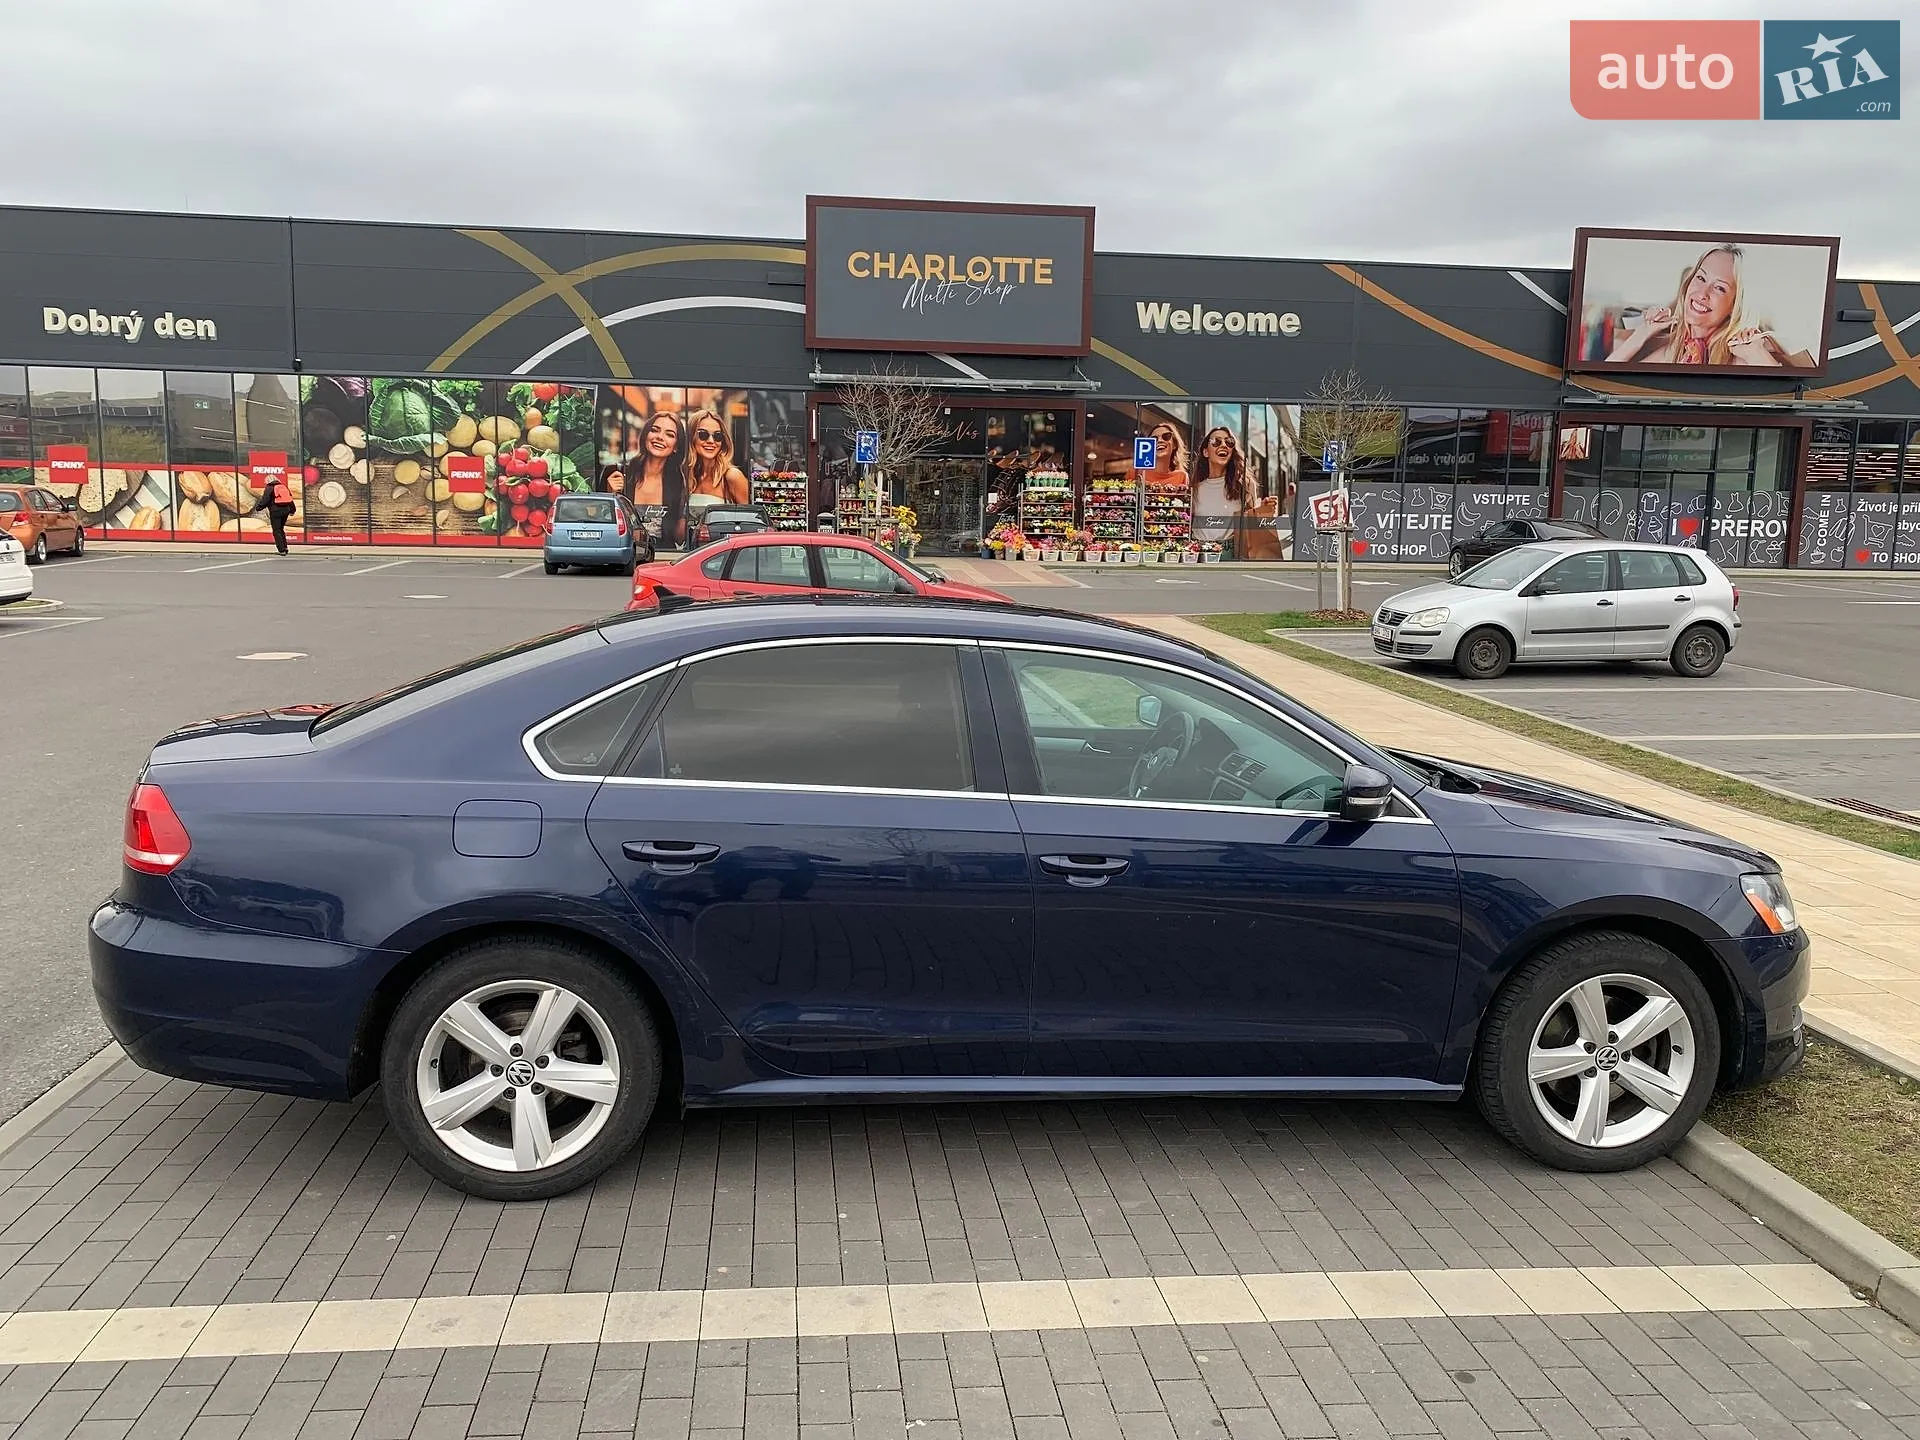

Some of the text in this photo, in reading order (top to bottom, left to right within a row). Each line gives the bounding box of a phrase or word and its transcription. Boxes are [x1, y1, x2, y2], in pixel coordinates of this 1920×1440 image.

[847, 251, 1054, 285] CHARLOTTE
[902, 271, 1017, 315] Multi Shop
[43, 306, 217, 342] Dobrý den
[1136, 301, 1302, 336] Welcome
[1139, 441, 1152, 459] P
[1472, 493, 1530, 506] VSTUPTE
[1857, 498, 1887, 512] Život
[1888, 501, 1899, 515] je
[1376, 509, 1453, 530] VÍTEJTE
[1671, 518, 1678, 536] I
[1816, 494, 1832, 547] COME IN
[1370, 543, 1427, 556] TO SHOP
[1872, 552, 1888, 563] TO
